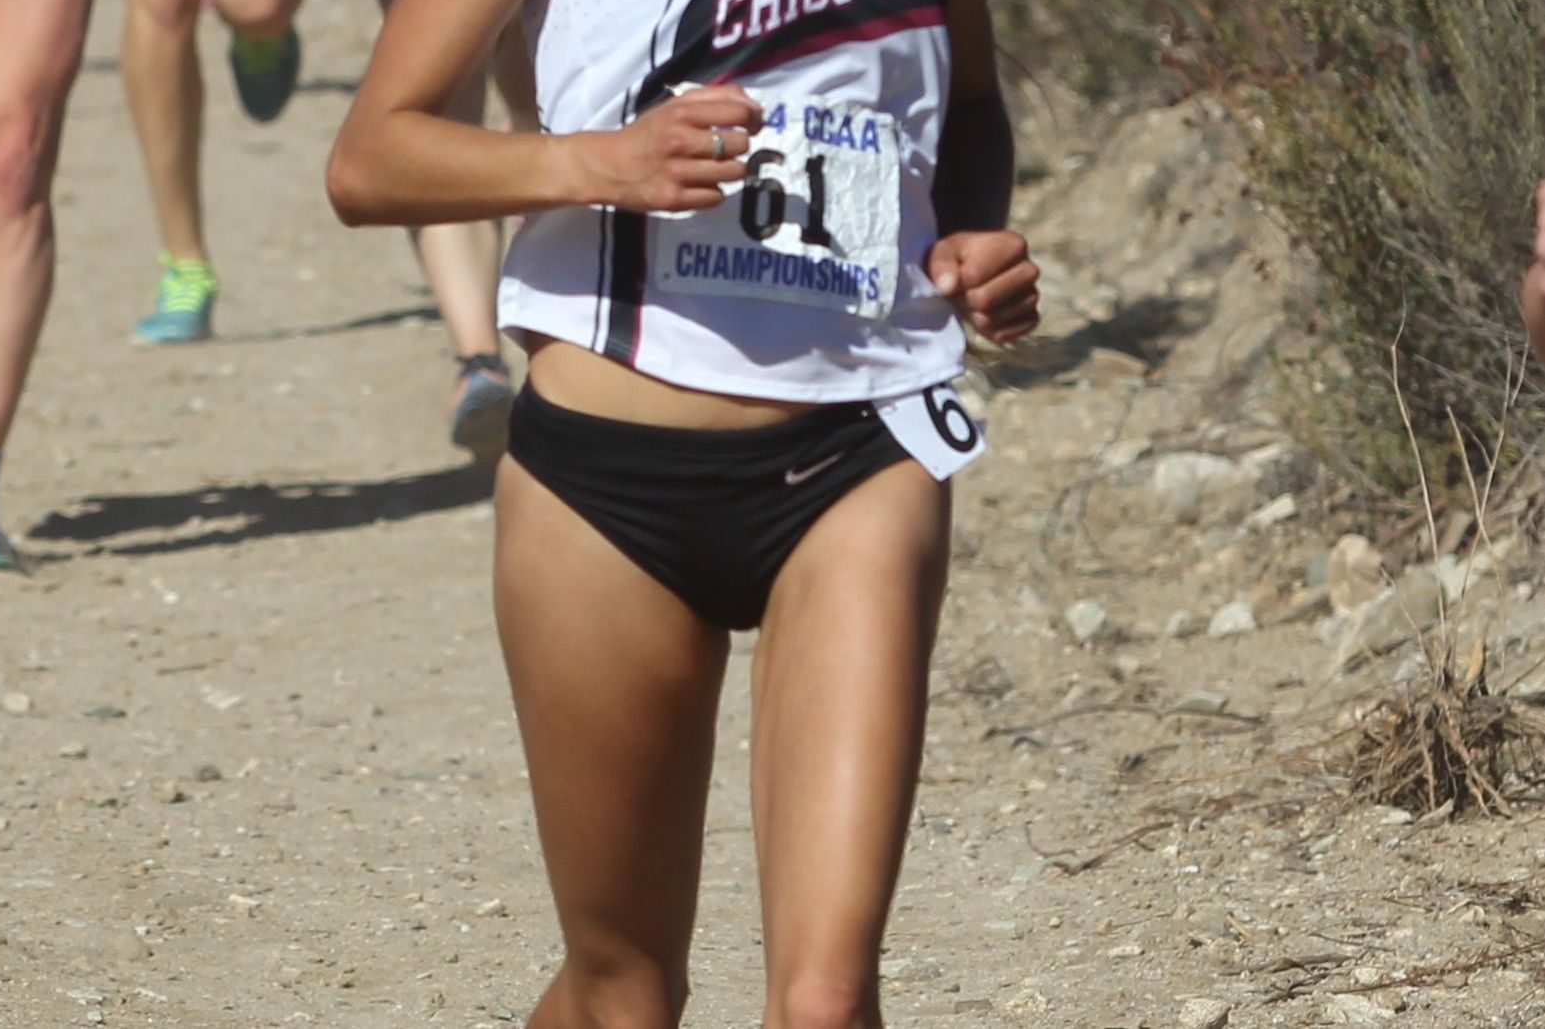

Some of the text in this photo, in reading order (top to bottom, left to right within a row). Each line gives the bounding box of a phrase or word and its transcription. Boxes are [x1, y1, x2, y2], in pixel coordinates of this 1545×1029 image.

[805, 105, 882, 154] CCAA
[739, 148, 832, 243] 61
[675, 241, 881, 302] CHAMPIONSHIPS
[922, 382, 977, 453] 6
